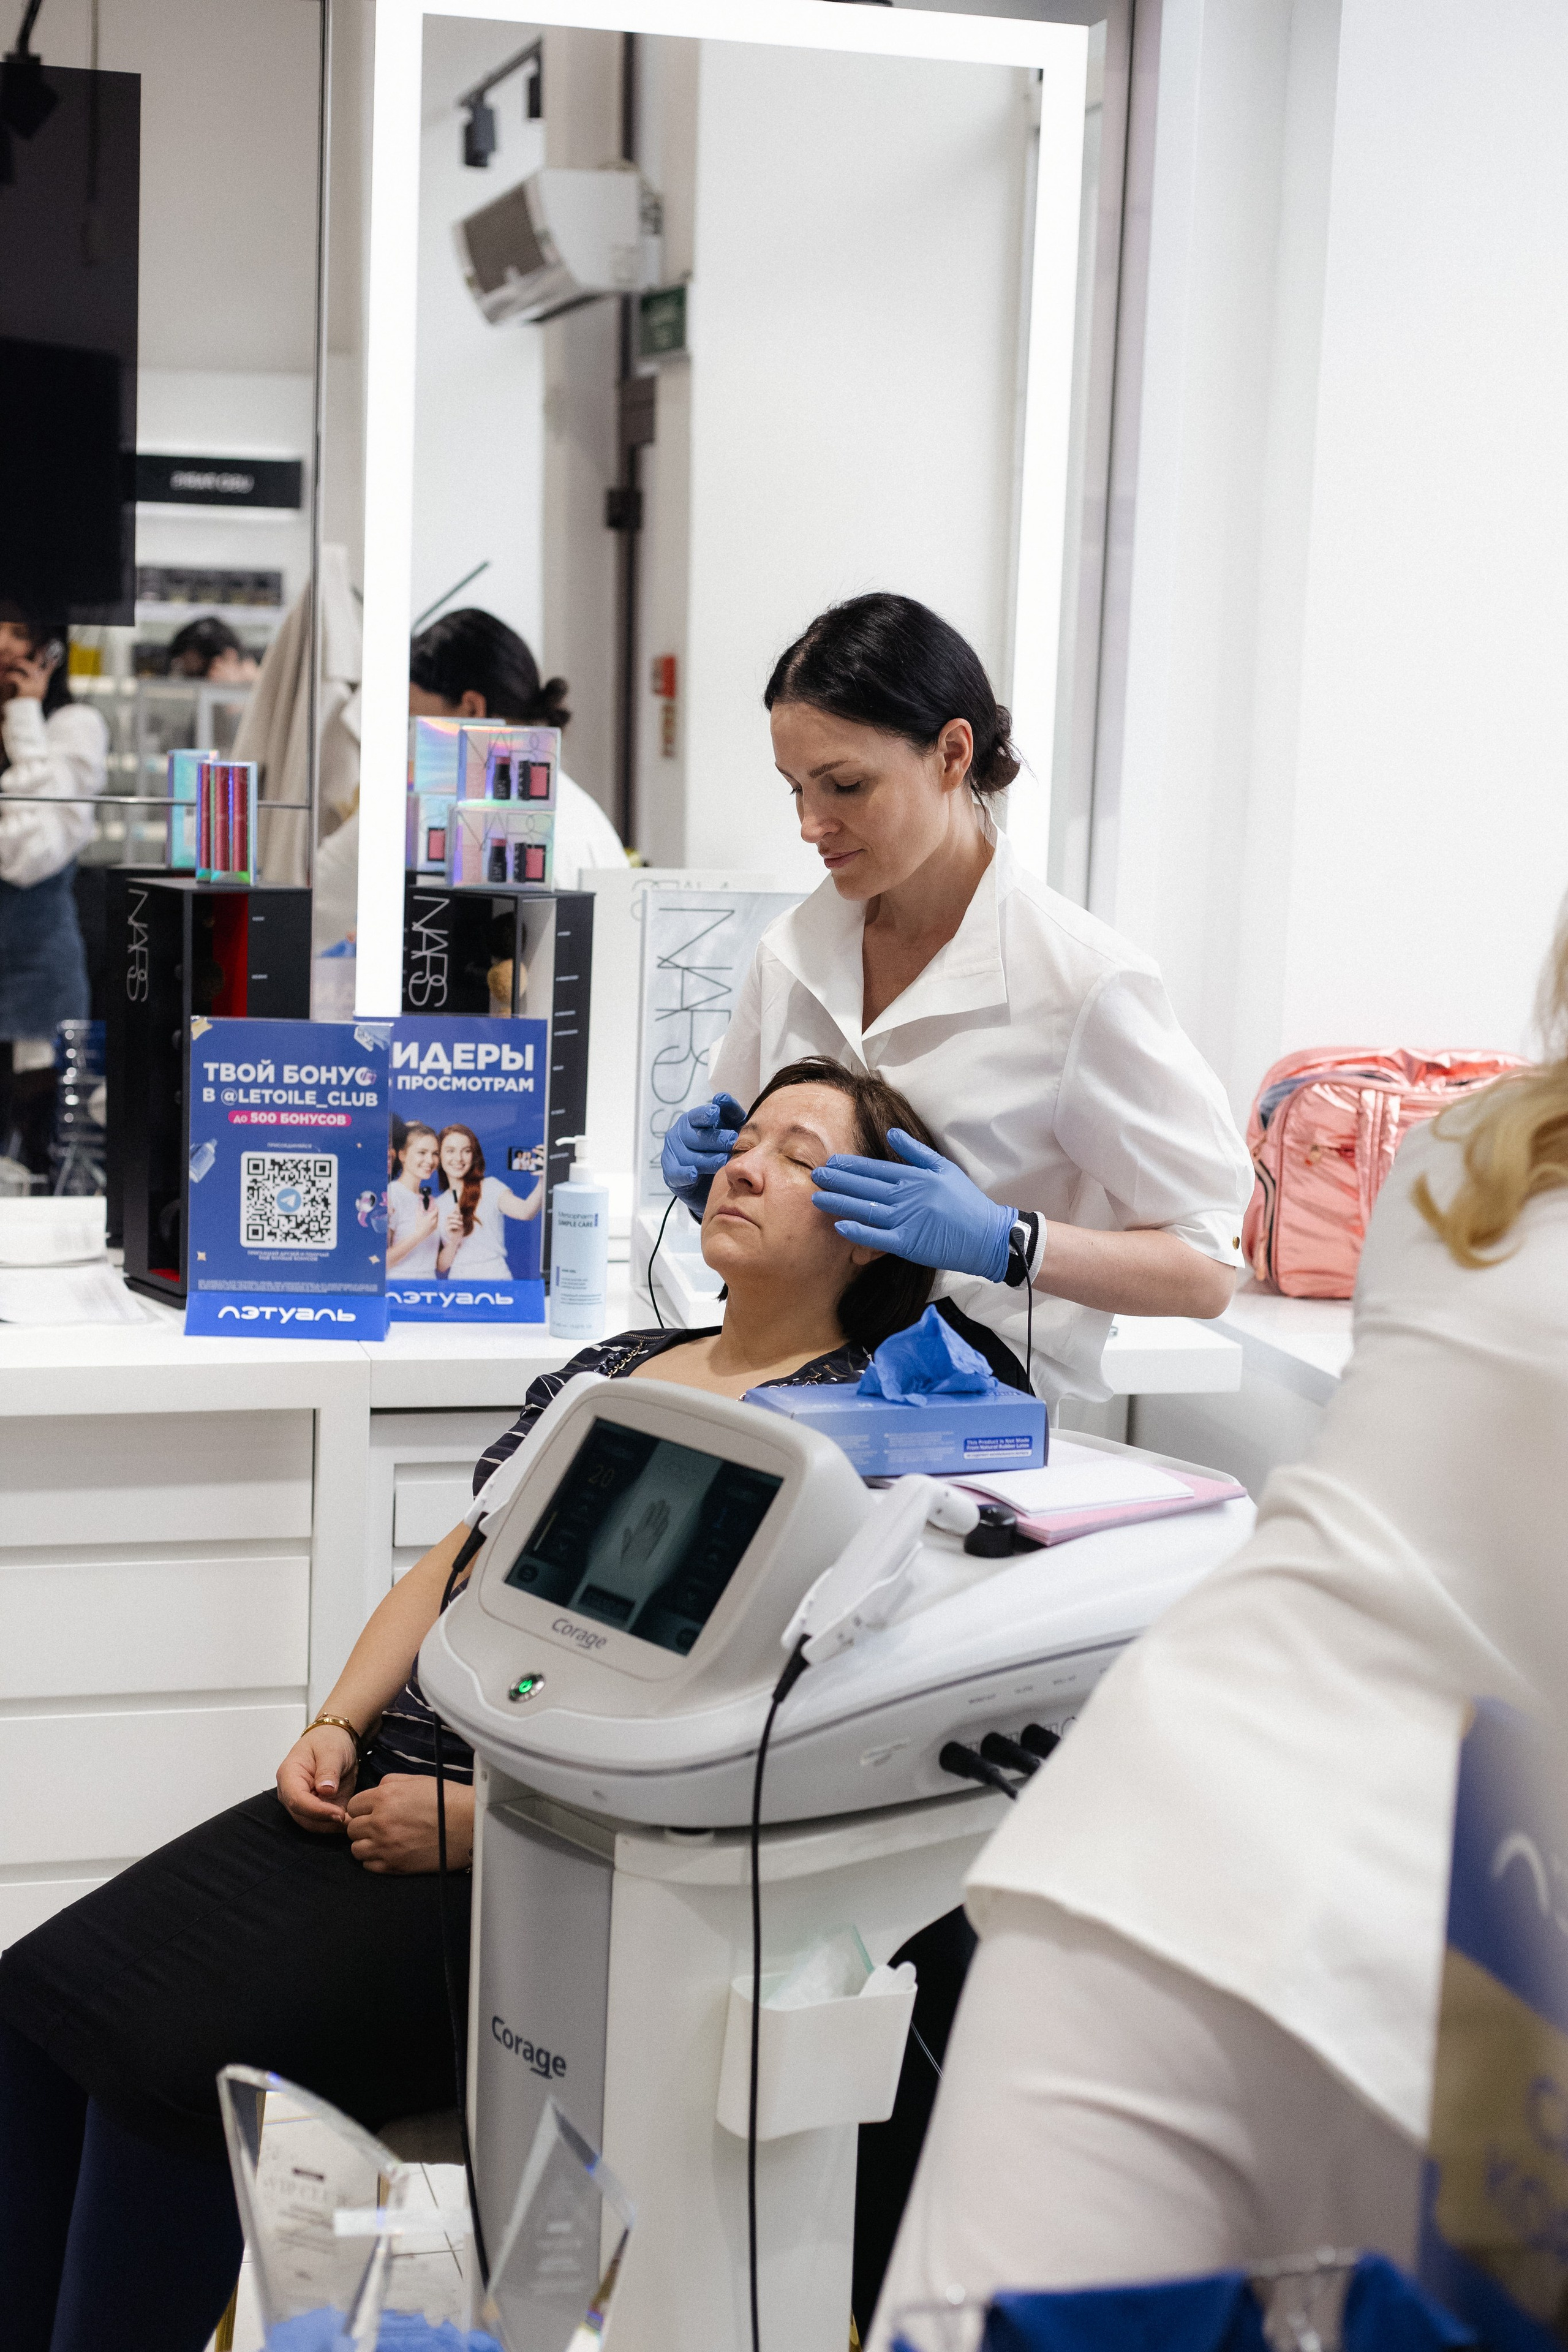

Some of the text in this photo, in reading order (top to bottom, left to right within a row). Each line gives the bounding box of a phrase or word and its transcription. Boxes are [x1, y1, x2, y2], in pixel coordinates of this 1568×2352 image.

[126, 888, 149, 1003] NARS
[408, 895, 451, 1008] NARS
[203, 1058, 275, 1083] ТВОЙ
[283, 1065, 373, 1087] БОНУС
[390, 1041, 535, 1076] ИДЕРЫ
[221, 1087, 379, 1109] @LETOILE_CLUB
[397, 1075, 534, 1093] ПРОСМОТРАМ
[251, 1112, 276, 1123] 500
[280, 1113, 346, 1126] БОНУСОВ
[551, 1617, 608, 1649] Corage
[491, 2015, 567, 2080] Corage
